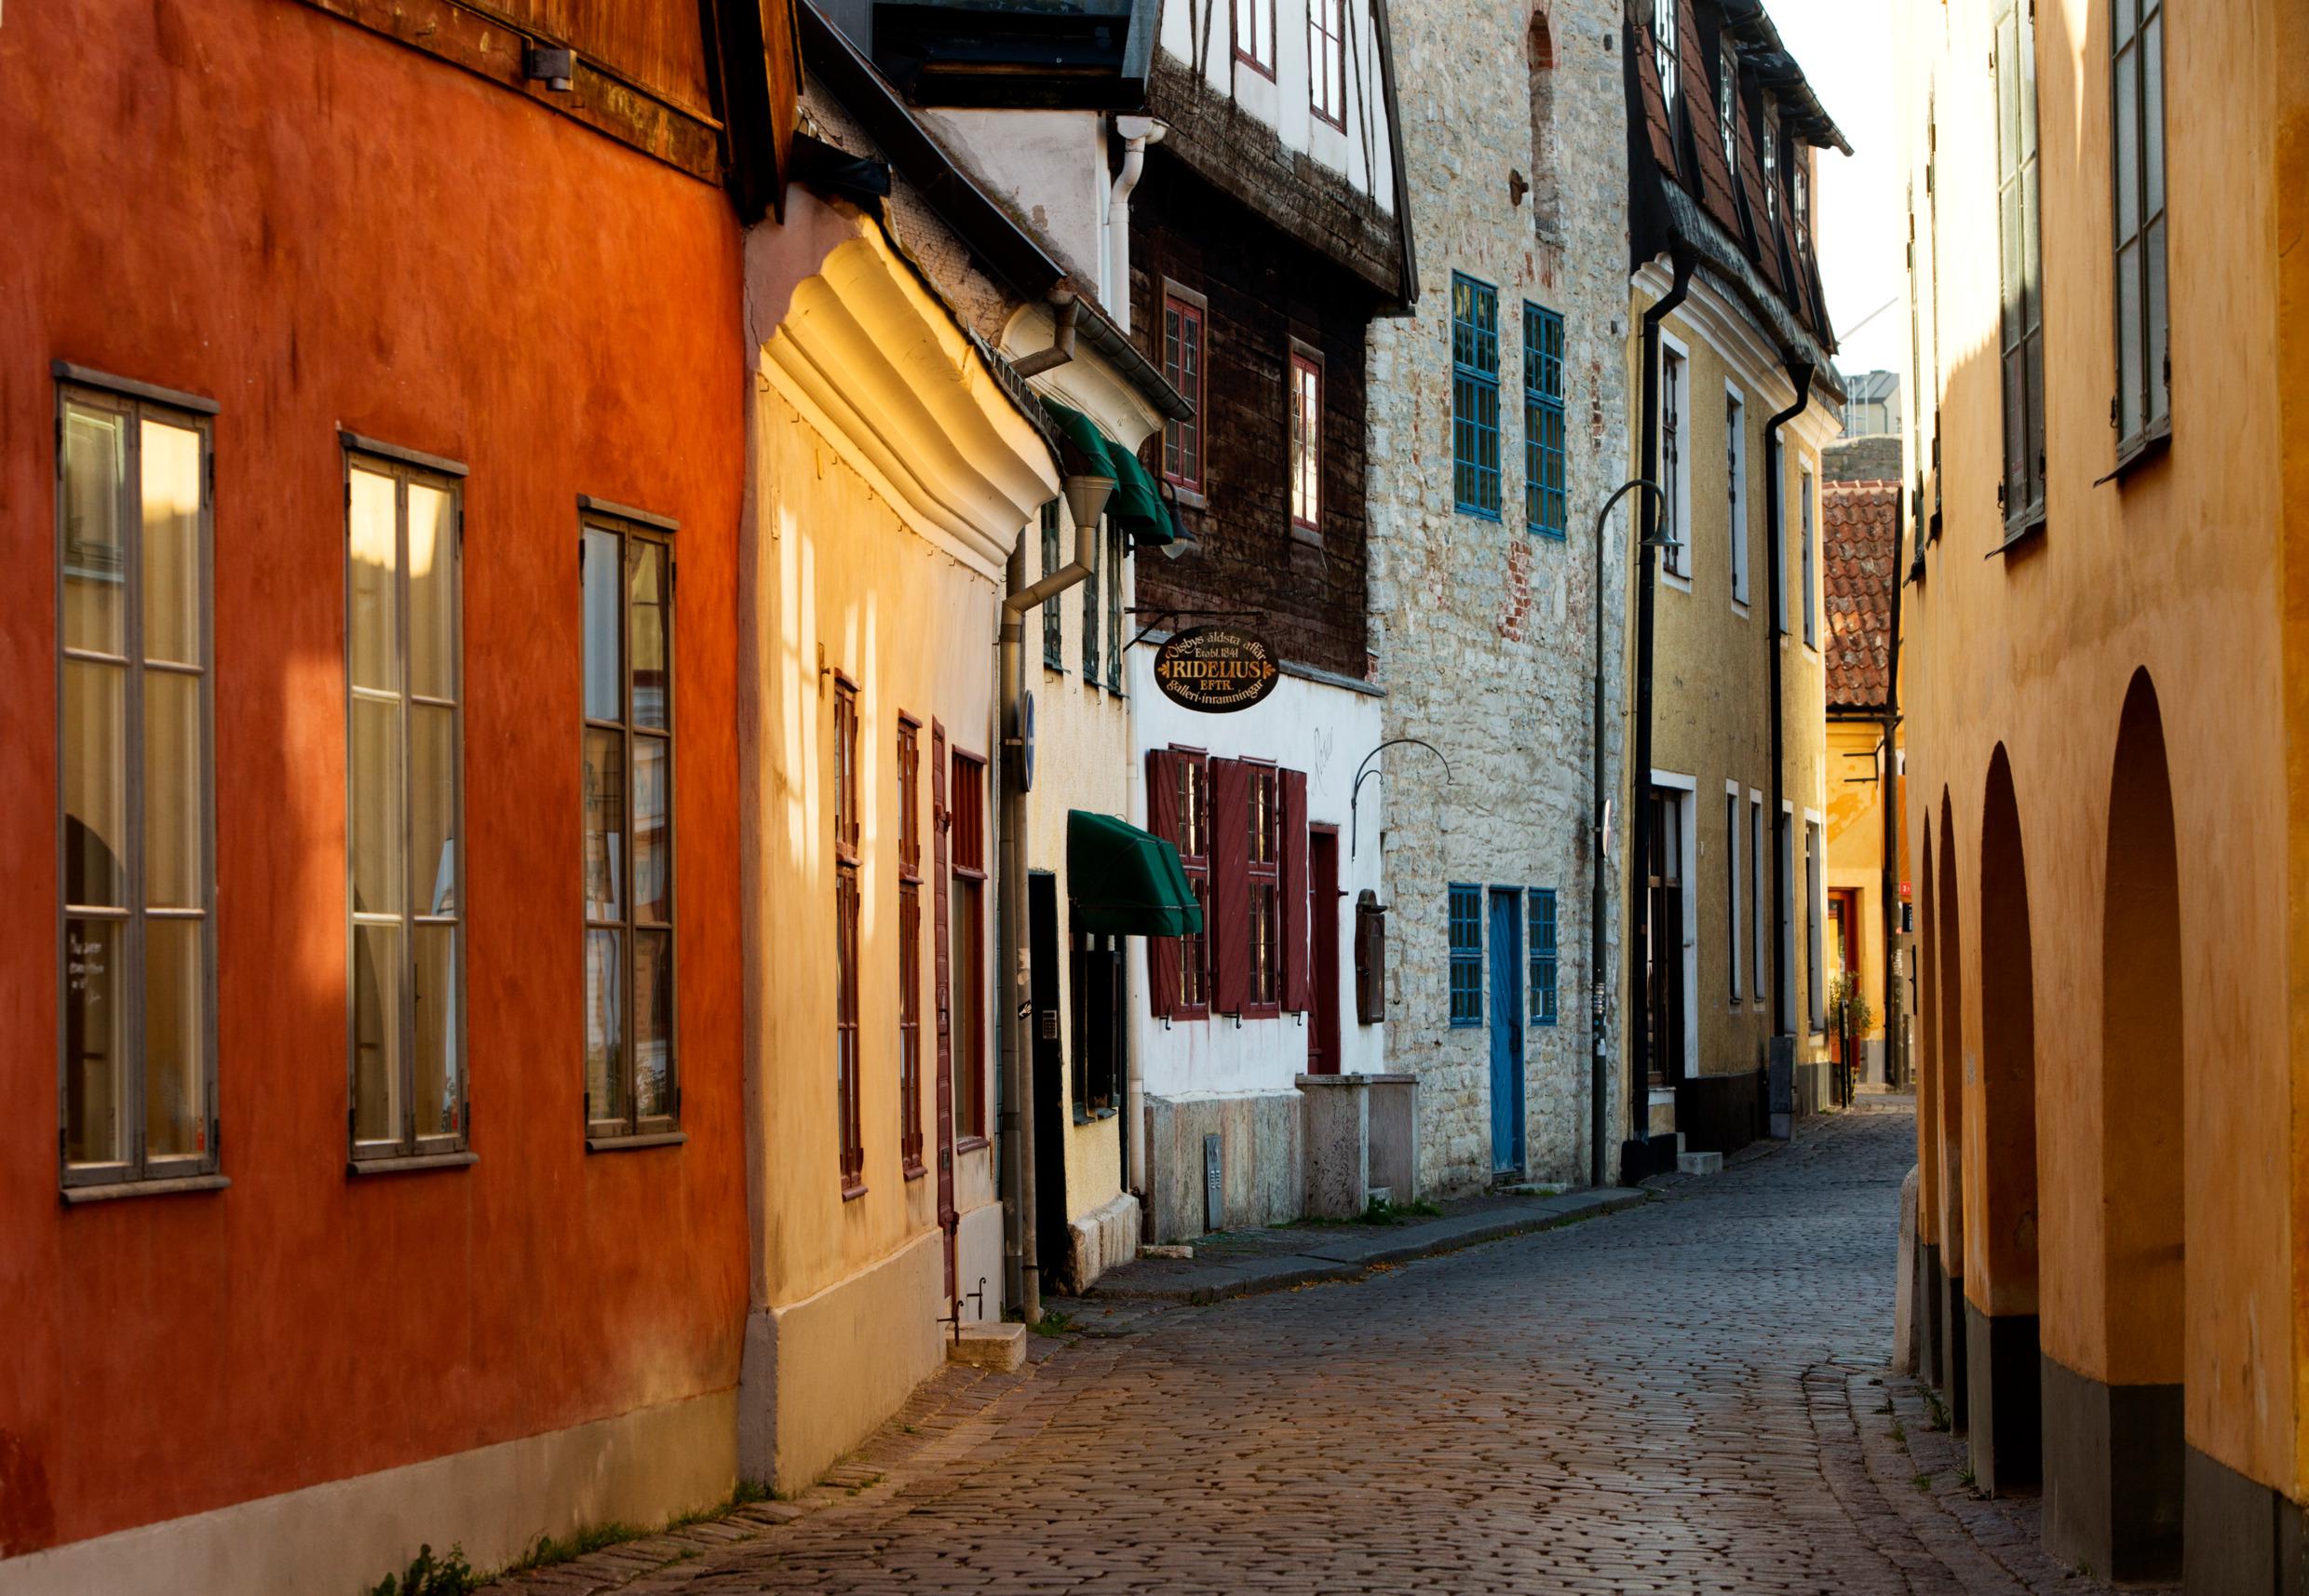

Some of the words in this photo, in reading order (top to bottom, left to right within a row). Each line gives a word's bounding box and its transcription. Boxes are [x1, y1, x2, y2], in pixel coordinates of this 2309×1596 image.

[1165, 635, 1204, 659] Visbys
[1207, 630, 1241, 645] äldsta
[1243, 641, 1266, 661] affär
[1172, 660, 1262, 679] RIDELIUS
[1199, 679, 1235, 691] EFTR.
